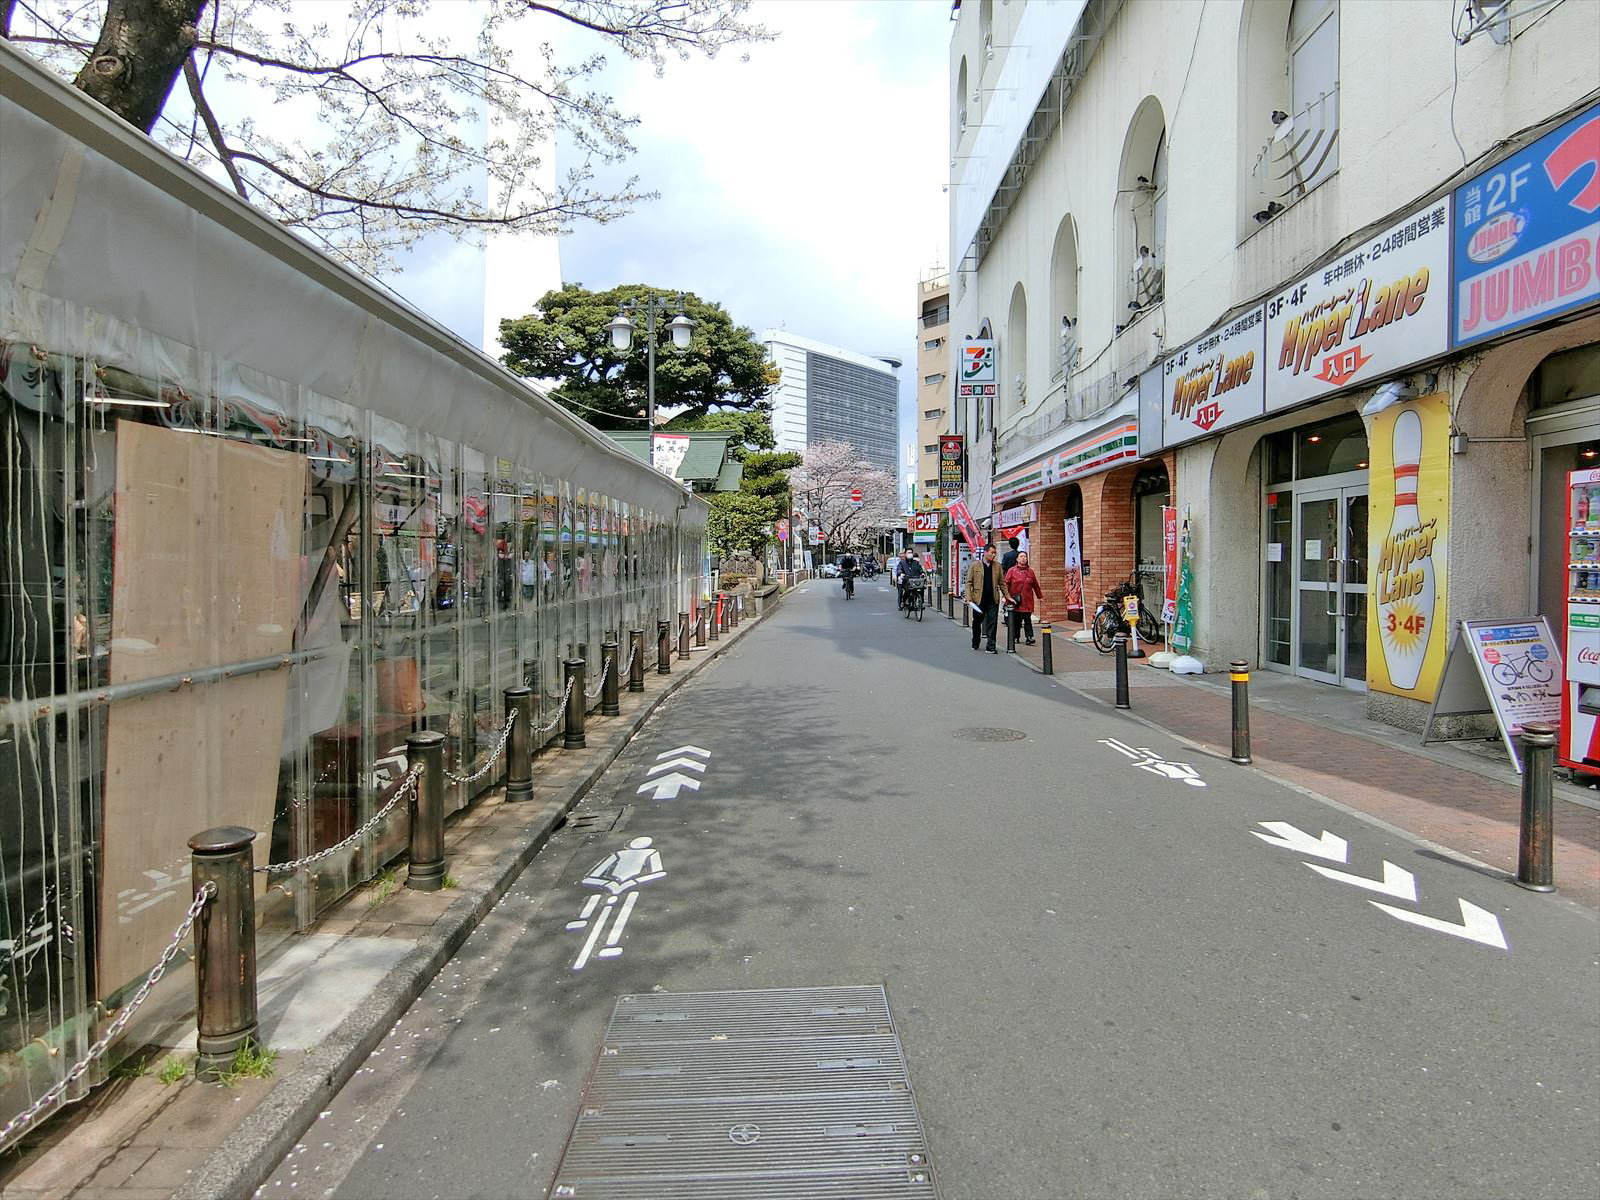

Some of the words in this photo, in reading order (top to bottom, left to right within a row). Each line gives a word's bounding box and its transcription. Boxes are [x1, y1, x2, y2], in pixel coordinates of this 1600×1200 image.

[1464, 185, 1481, 228] 当館
[1486, 162, 1531, 216] 2F
[1462, 235, 1600, 333] JUMB
[1278, 304, 1353, 376] Hyper
[1354, 265, 1430, 341] Lane
[1301, 287, 1355, 326] ハイパーレーン
[1171, 371, 1214, 420] Hyper
[1214, 350, 1254, 397] Lane
[1327, 351, 1356, 381] 入口
[1199, 406, 1216, 425] 入口
[916, 513, 939, 529] つり具
[1380, 528, 1437, 578] Hyper
[1380, 567, 1425, 605] Lane
